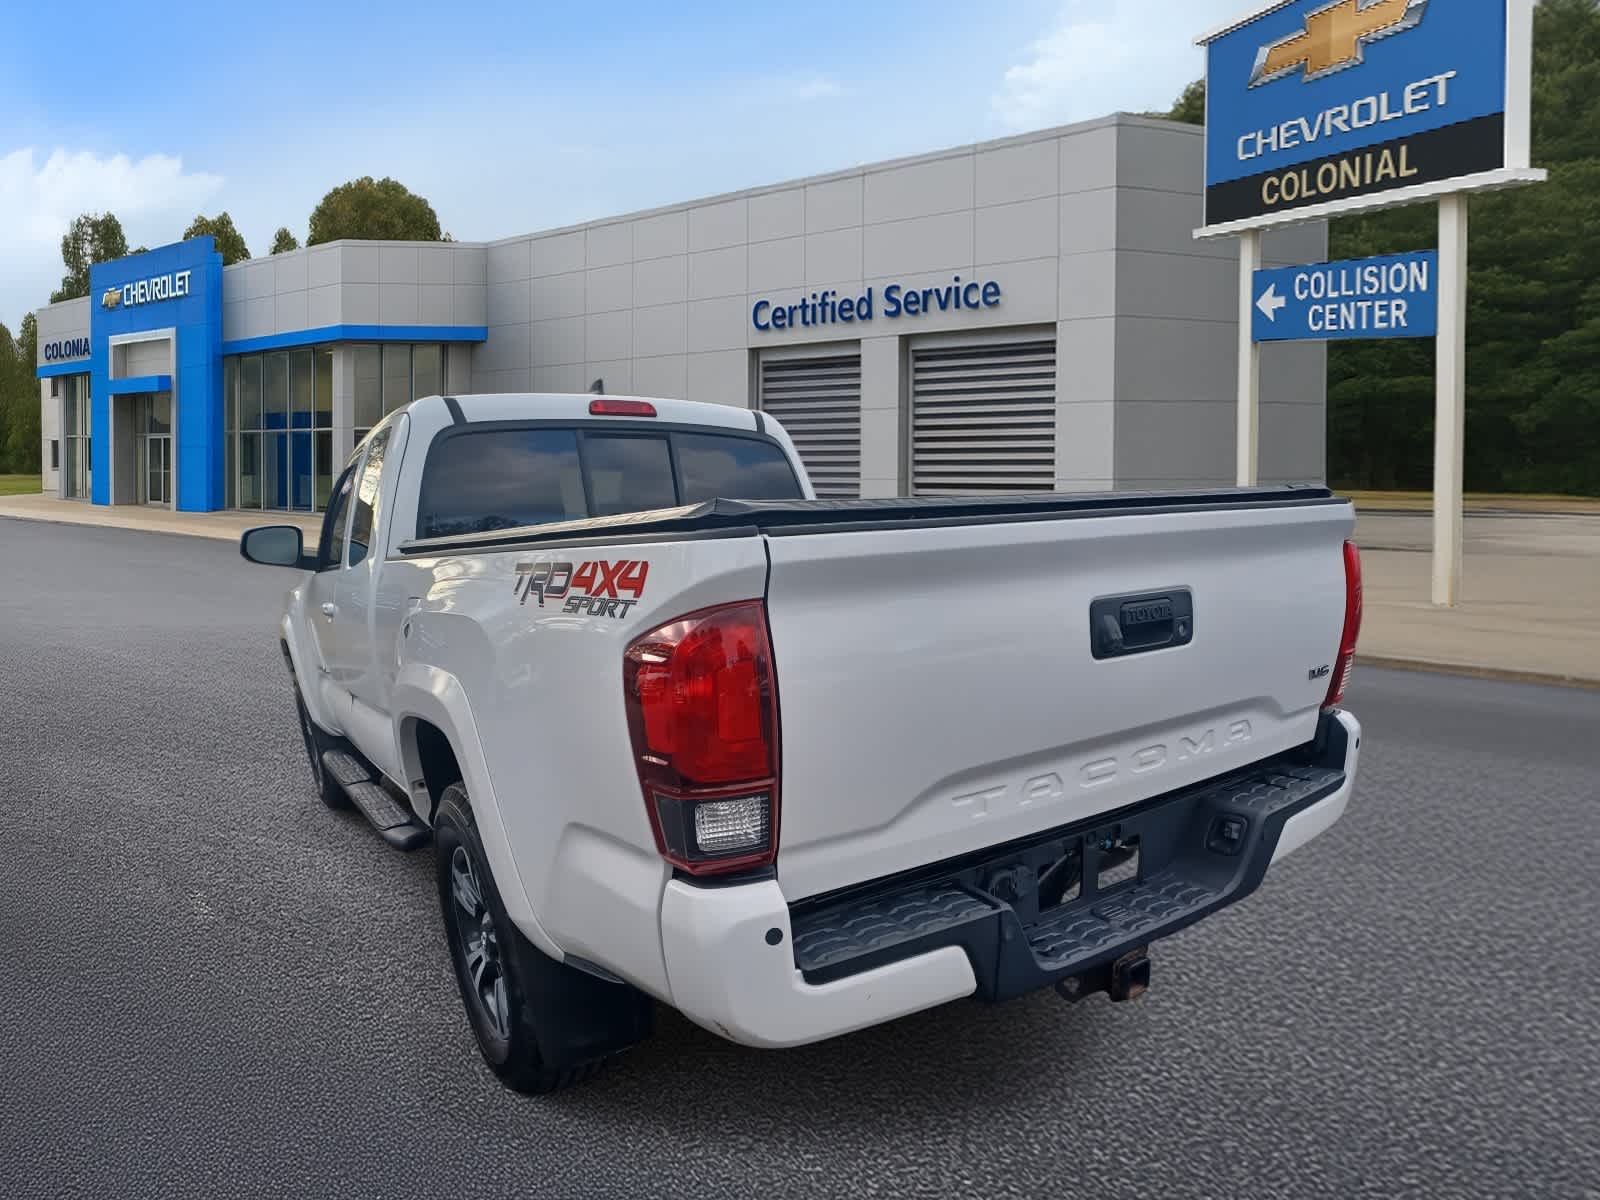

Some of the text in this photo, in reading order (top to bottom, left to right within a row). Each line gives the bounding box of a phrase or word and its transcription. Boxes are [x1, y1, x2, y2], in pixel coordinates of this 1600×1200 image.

[1236, 70, 1457, 161] CHEVROLET
[1261, 144, 1419, 206] COLONIAL
[123, 270, 192, 306] CHEVROLET
[752, 275, 1002, 331] Certified Service
[1294, 260, 1429, 301] COLLISION
[1308, 299, 1409, 332] CENTER
[561, 594, 638, 619] SPORT
[950, 718, 1253, 818] TACOMA
